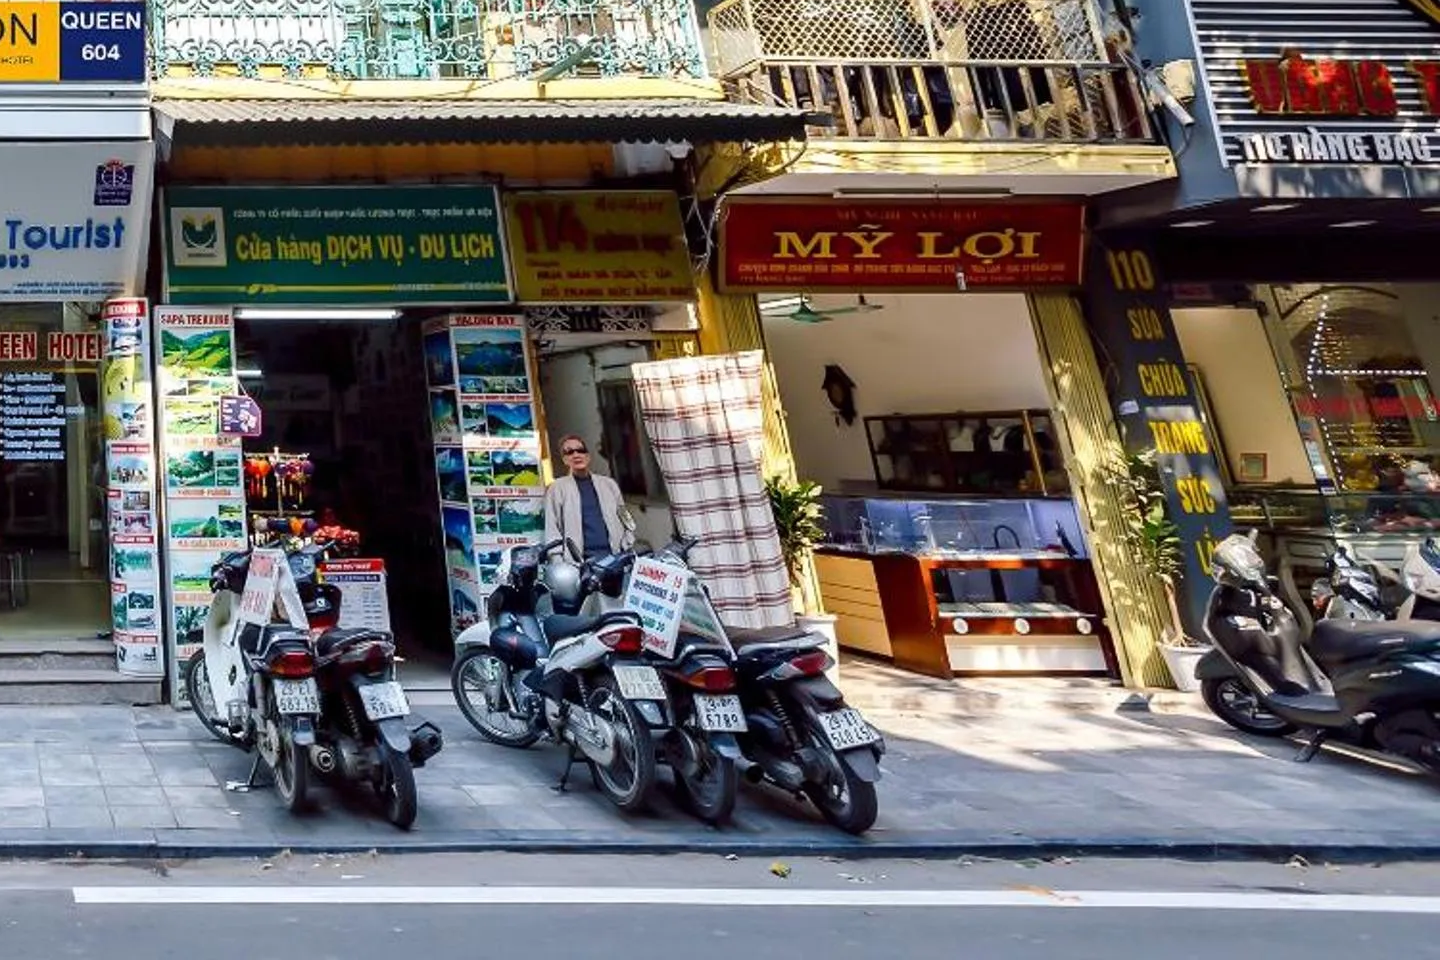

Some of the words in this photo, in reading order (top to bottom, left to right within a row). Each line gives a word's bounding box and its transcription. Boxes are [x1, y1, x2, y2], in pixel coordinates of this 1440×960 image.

[61, 10, 142, 31] QUEEN
[81, 43, 121, 62] 604
[1291, 126, 1371, 162] HÀNG
[276, 231, 323, 266] hàng
[418, 233, 447, 260] DU
[773, 223, 895, 259] MỸ
[916, 227, 1043, 265] LỢI
[1107, 249, 1156, 291] 110
